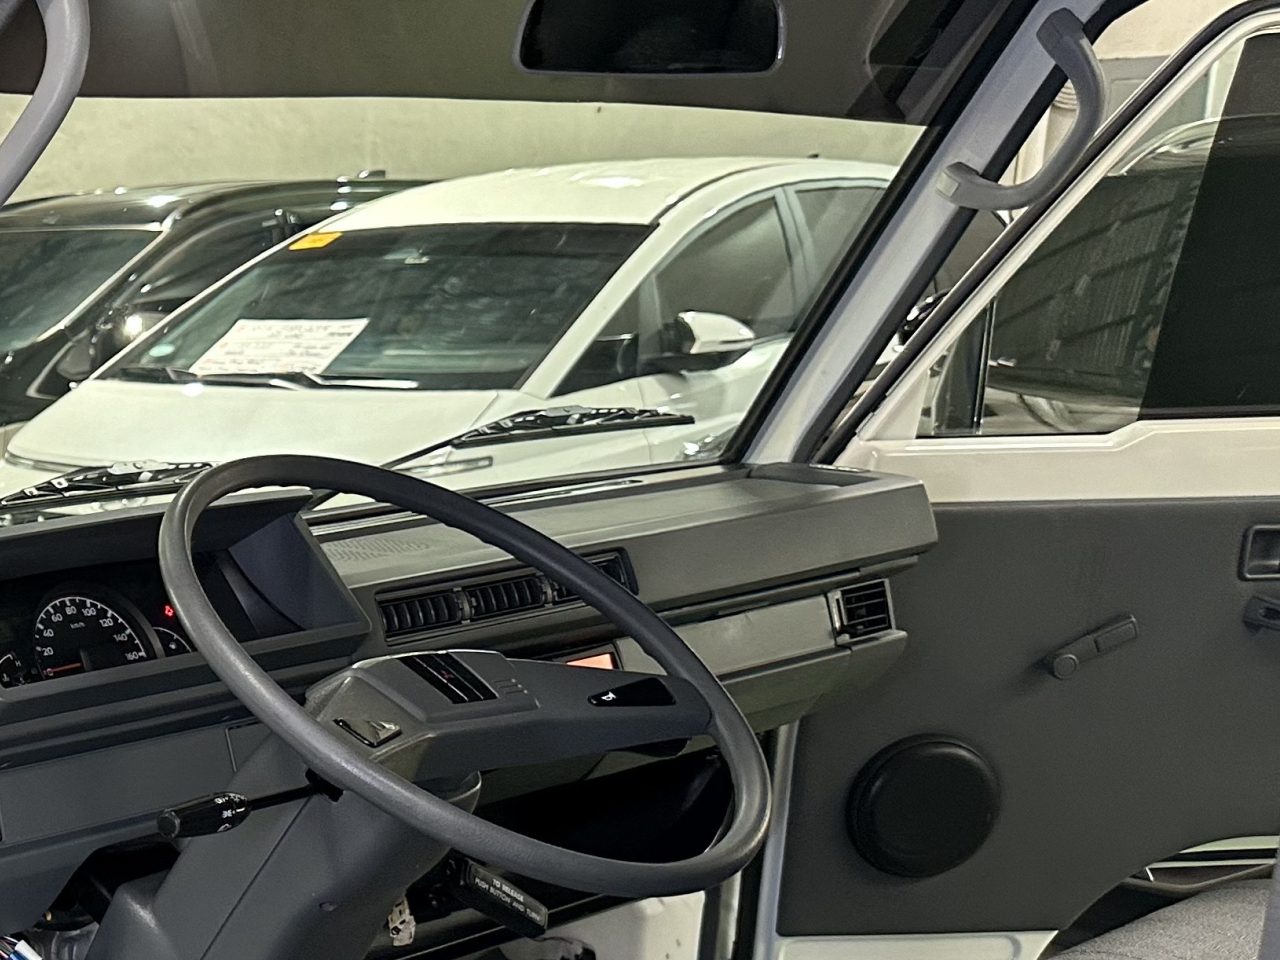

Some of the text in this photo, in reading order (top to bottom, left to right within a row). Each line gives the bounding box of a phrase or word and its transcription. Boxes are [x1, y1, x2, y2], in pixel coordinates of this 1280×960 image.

[65, 606, 77, 615] 80
[81, 607, 96, 616] 100
[51, 613, 63, 622] 60
[99, 618, 114, 627] 120
[43, 628, 54, 637] 40
[113, 633, 128, 642] 140
[42, 646, 54, 656] 20
[125, 651, 139, 660] 160
[492, 878, 524, 902] TO RELEASE
